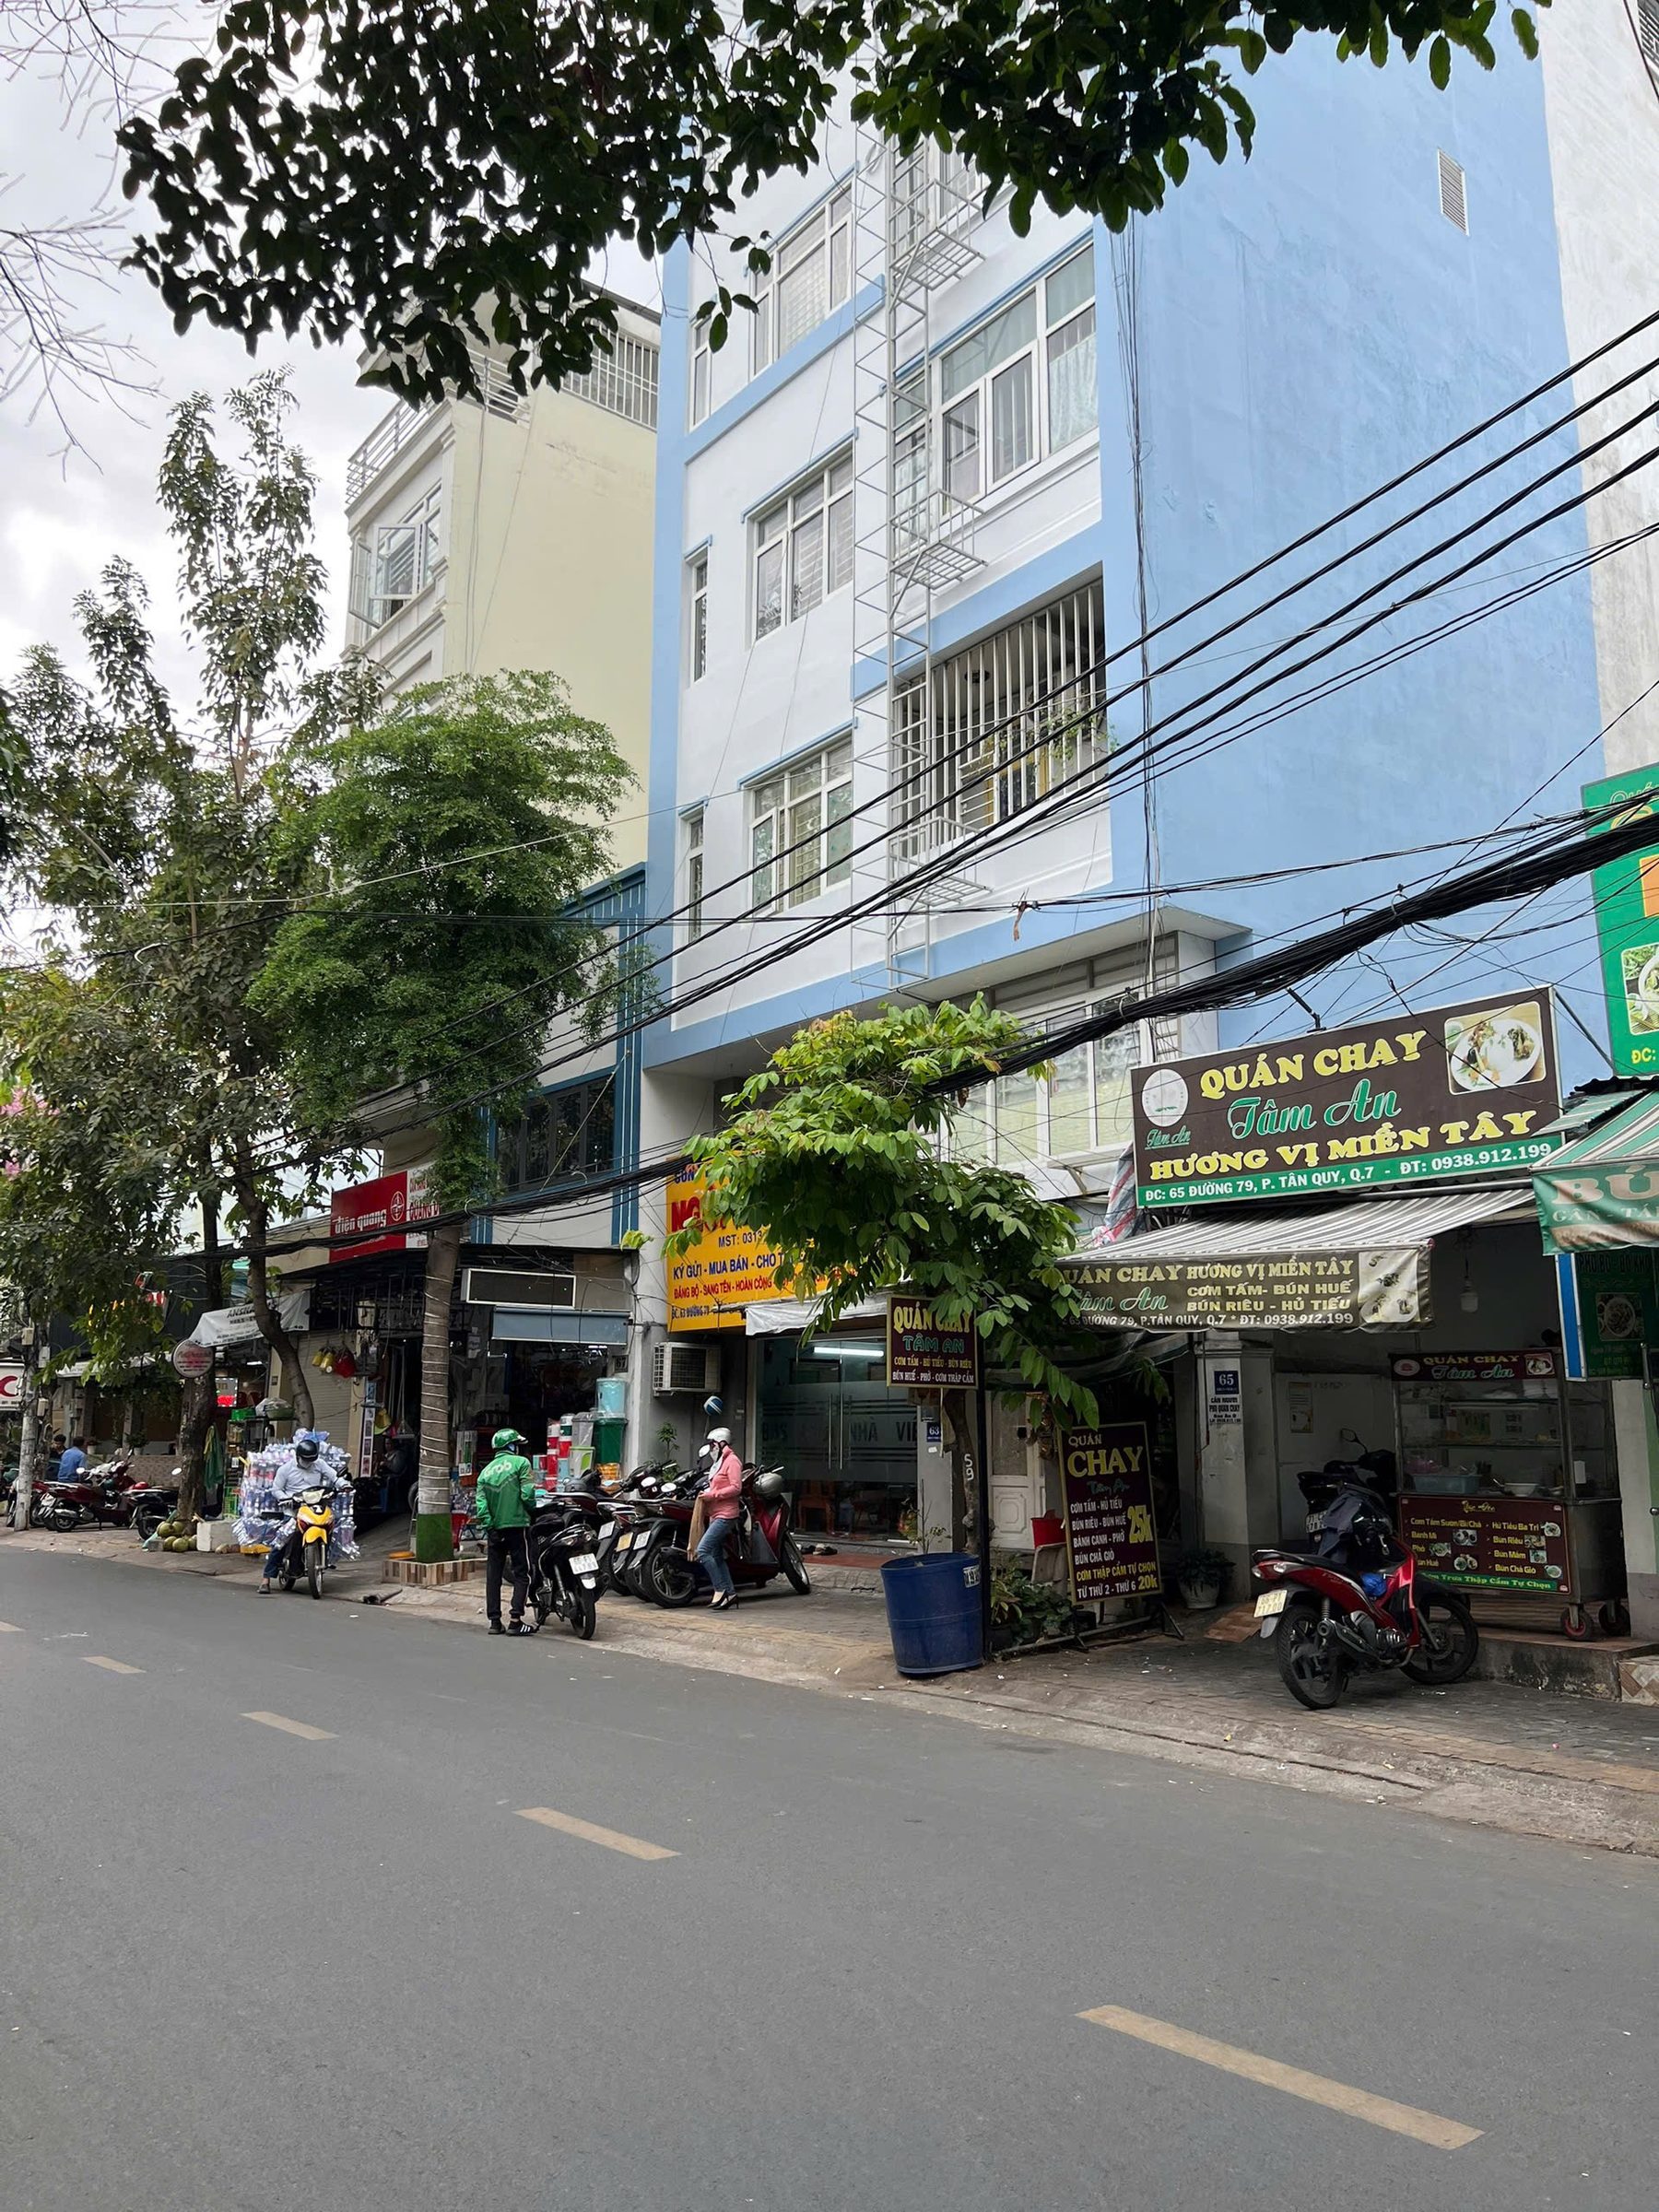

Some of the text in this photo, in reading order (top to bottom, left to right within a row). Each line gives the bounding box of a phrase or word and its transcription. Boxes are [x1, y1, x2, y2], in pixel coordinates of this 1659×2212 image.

[1200, 1030, 1427, 1100] QUÁN CHAY
[1227, 1078, 1402, 1139] Tâm An
[1149, 1111, 1536, 1180] HƯƠNG VỊ MIỀN TÂY
[1146, 1189, 1165, 1201] ĐC:
[1170, 1187, 1184, 1198] 65
[1189, 1180, 1233, 1197] ĐƯỜNG
[1236, 1181, 1257, 1194] 79,
[1262, 1180, 1275, 1190] P.
[1279, 1173, 1308, 1188] TÂN
[1349, 1167, 1374, 1181] Q.7
[1400, 1161, 1427, 1175] ĐT:
[1431, 1143, 1552, 1171] 0938.912.199
[718, 1234, 740, 1248] MST:
[673, 1263, 685, 1280] KÝ
[709, 1260, 727, 1275] MUA
[729, 1254, 748, 1272] BÁN
[756, 1253, 776, 1268] CHO
[1061, 1255, 1354, 1284] UÁN CHAY HƯƠNG VỊ MIỀN TÂY
[1187, 1285, 1222, 1297] CƠM
[1273, 1280, 1310, 1295] BÚN
[1314, 1278, 1354, 1294] HUẾ
[1120, 1287, 1169, 1311] An
[1186, 1295, 1351, 1312] BÚN RIÊU HỦ TIẾU
[893, 1300, 933, 1334] QUÁN
[1120, 1315, 1138, 1327] 79,
[1140, 1313, 1172, 1326] P.TÂN
[1206, 1314, 1227, 1325] Q.7
[1240, 1315, 1260, 1325] ĐT:
[1265, 1312, 1354, 1325] 0938.912.199
[902, 1333, 965, 1353] TÂM AN
[1423, 1354, 1519, 1365] QUÁN CHAY
[1218, 1373, 1234, 1386] 65
[1431, 1363, 1516, 1379] Tâm An
[929, 1425, 940, 1435] 63
[1068, 1432, 1102, 1448] QUÁN
[1067, 1445, 1144, 1477] CHAY
[1070, 1502, 1083, 1513] CƠM
[1084, 1499, 1096, 1512] TẤM
[1072, 1518, 1084, 1531] BÚN
[1073, 1535, 1090, 1548] BÁNH
[1075, 1552, 1088, 1565] BÚN
[1089, 1548, 1102, 1563] CHẢ
[1077, 1569, 1091, 1582] CƠM
[1137, 1574, 1158, 1591] 20k
[1104, 1584, 1111, 1595] 2
[1131, 1581, 1136, 1591] 6
